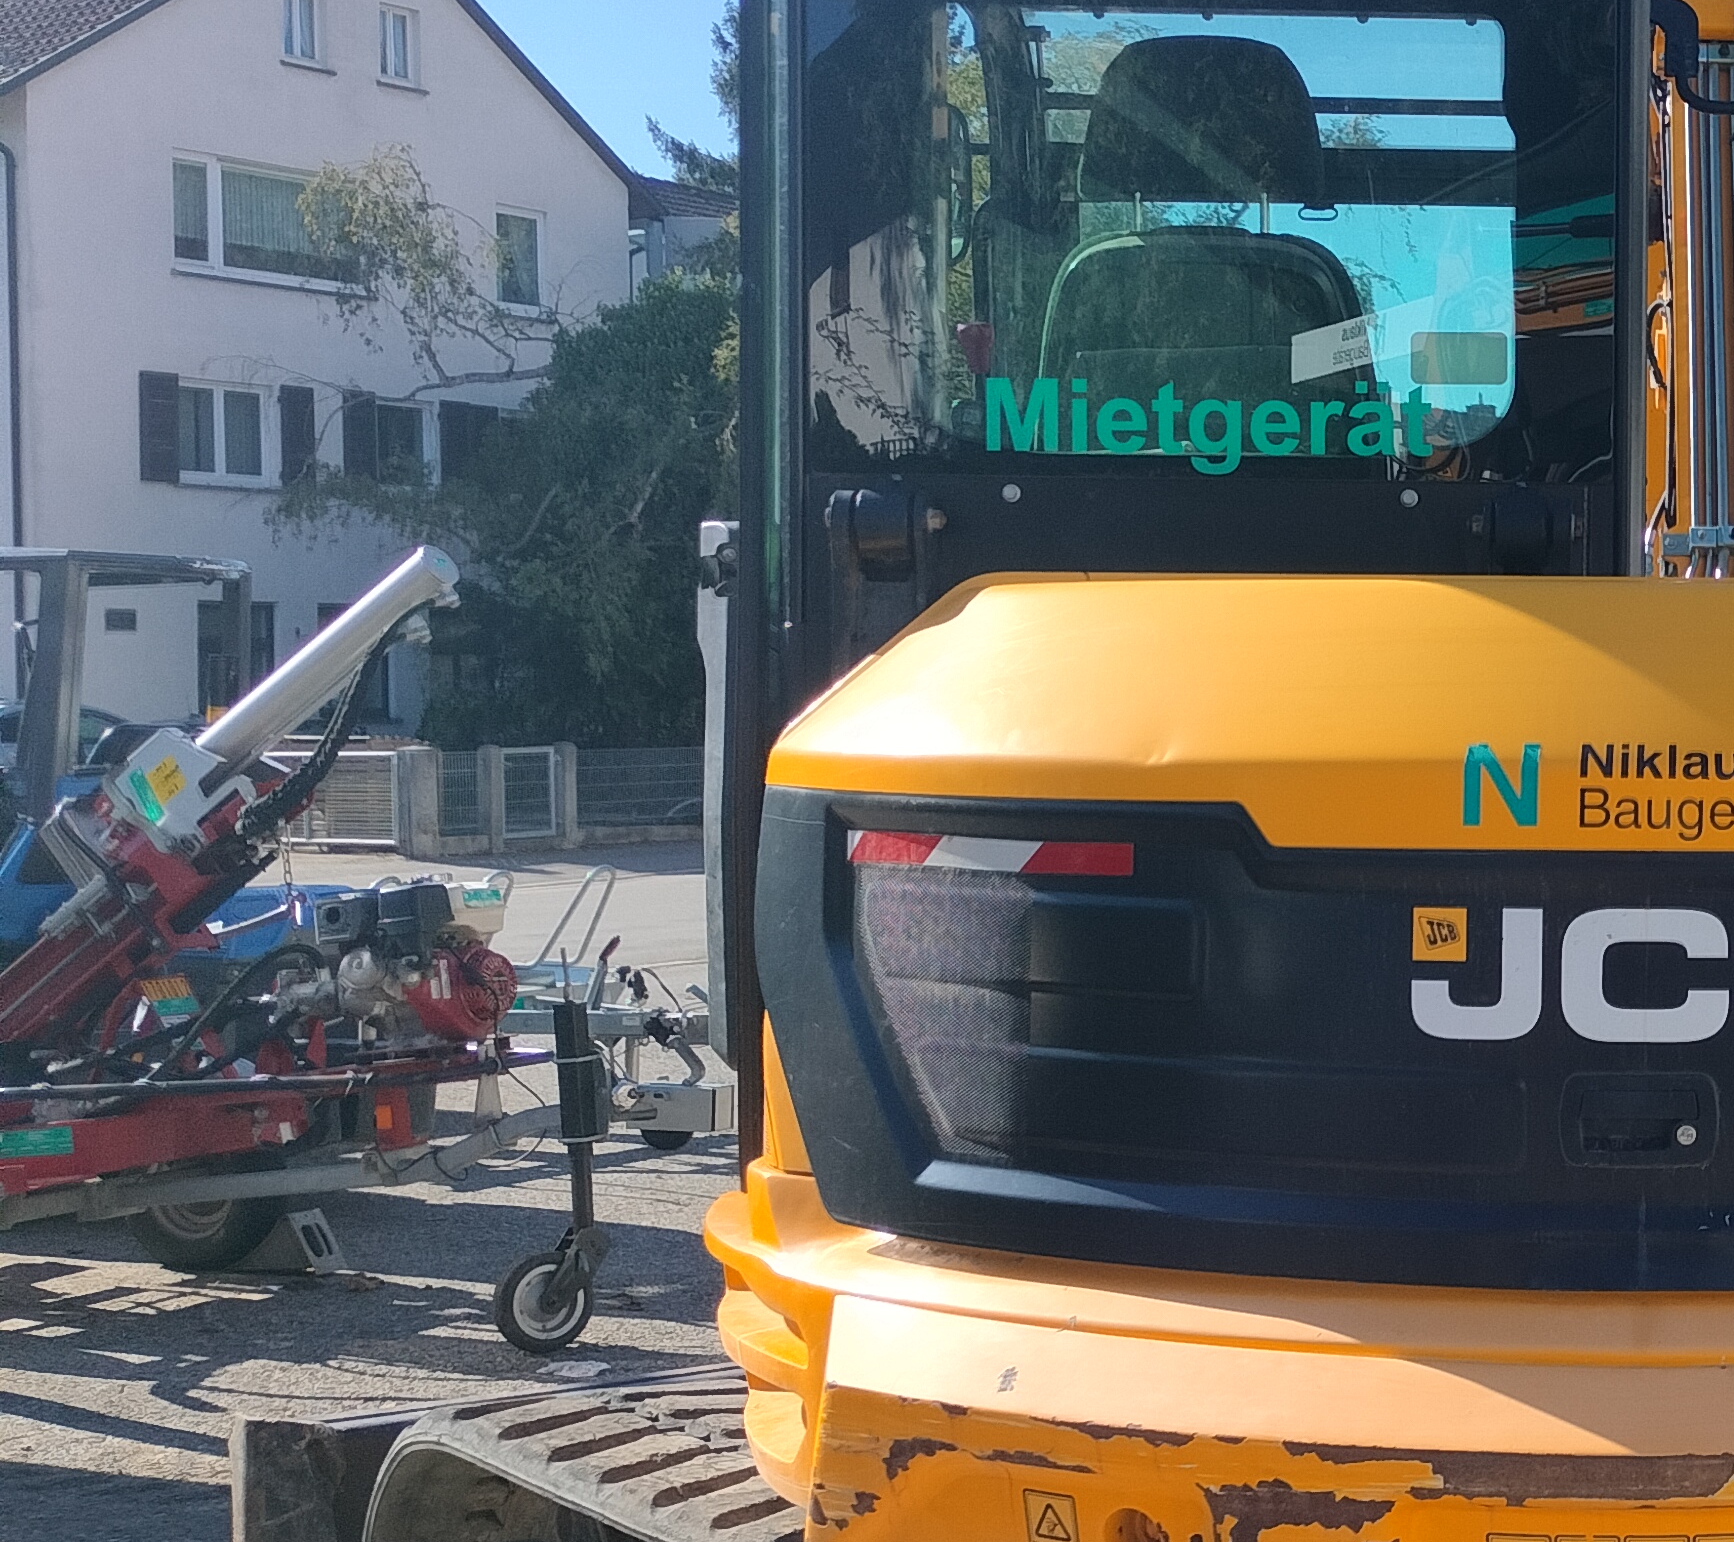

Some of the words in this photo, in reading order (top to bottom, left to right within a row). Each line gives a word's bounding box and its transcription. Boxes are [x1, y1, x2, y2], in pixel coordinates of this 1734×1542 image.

[986, 377, 1433, 476] Mietgerät
[1462, 743, 1541, 827] N
[1426, 920, 1457, 946] JCB
